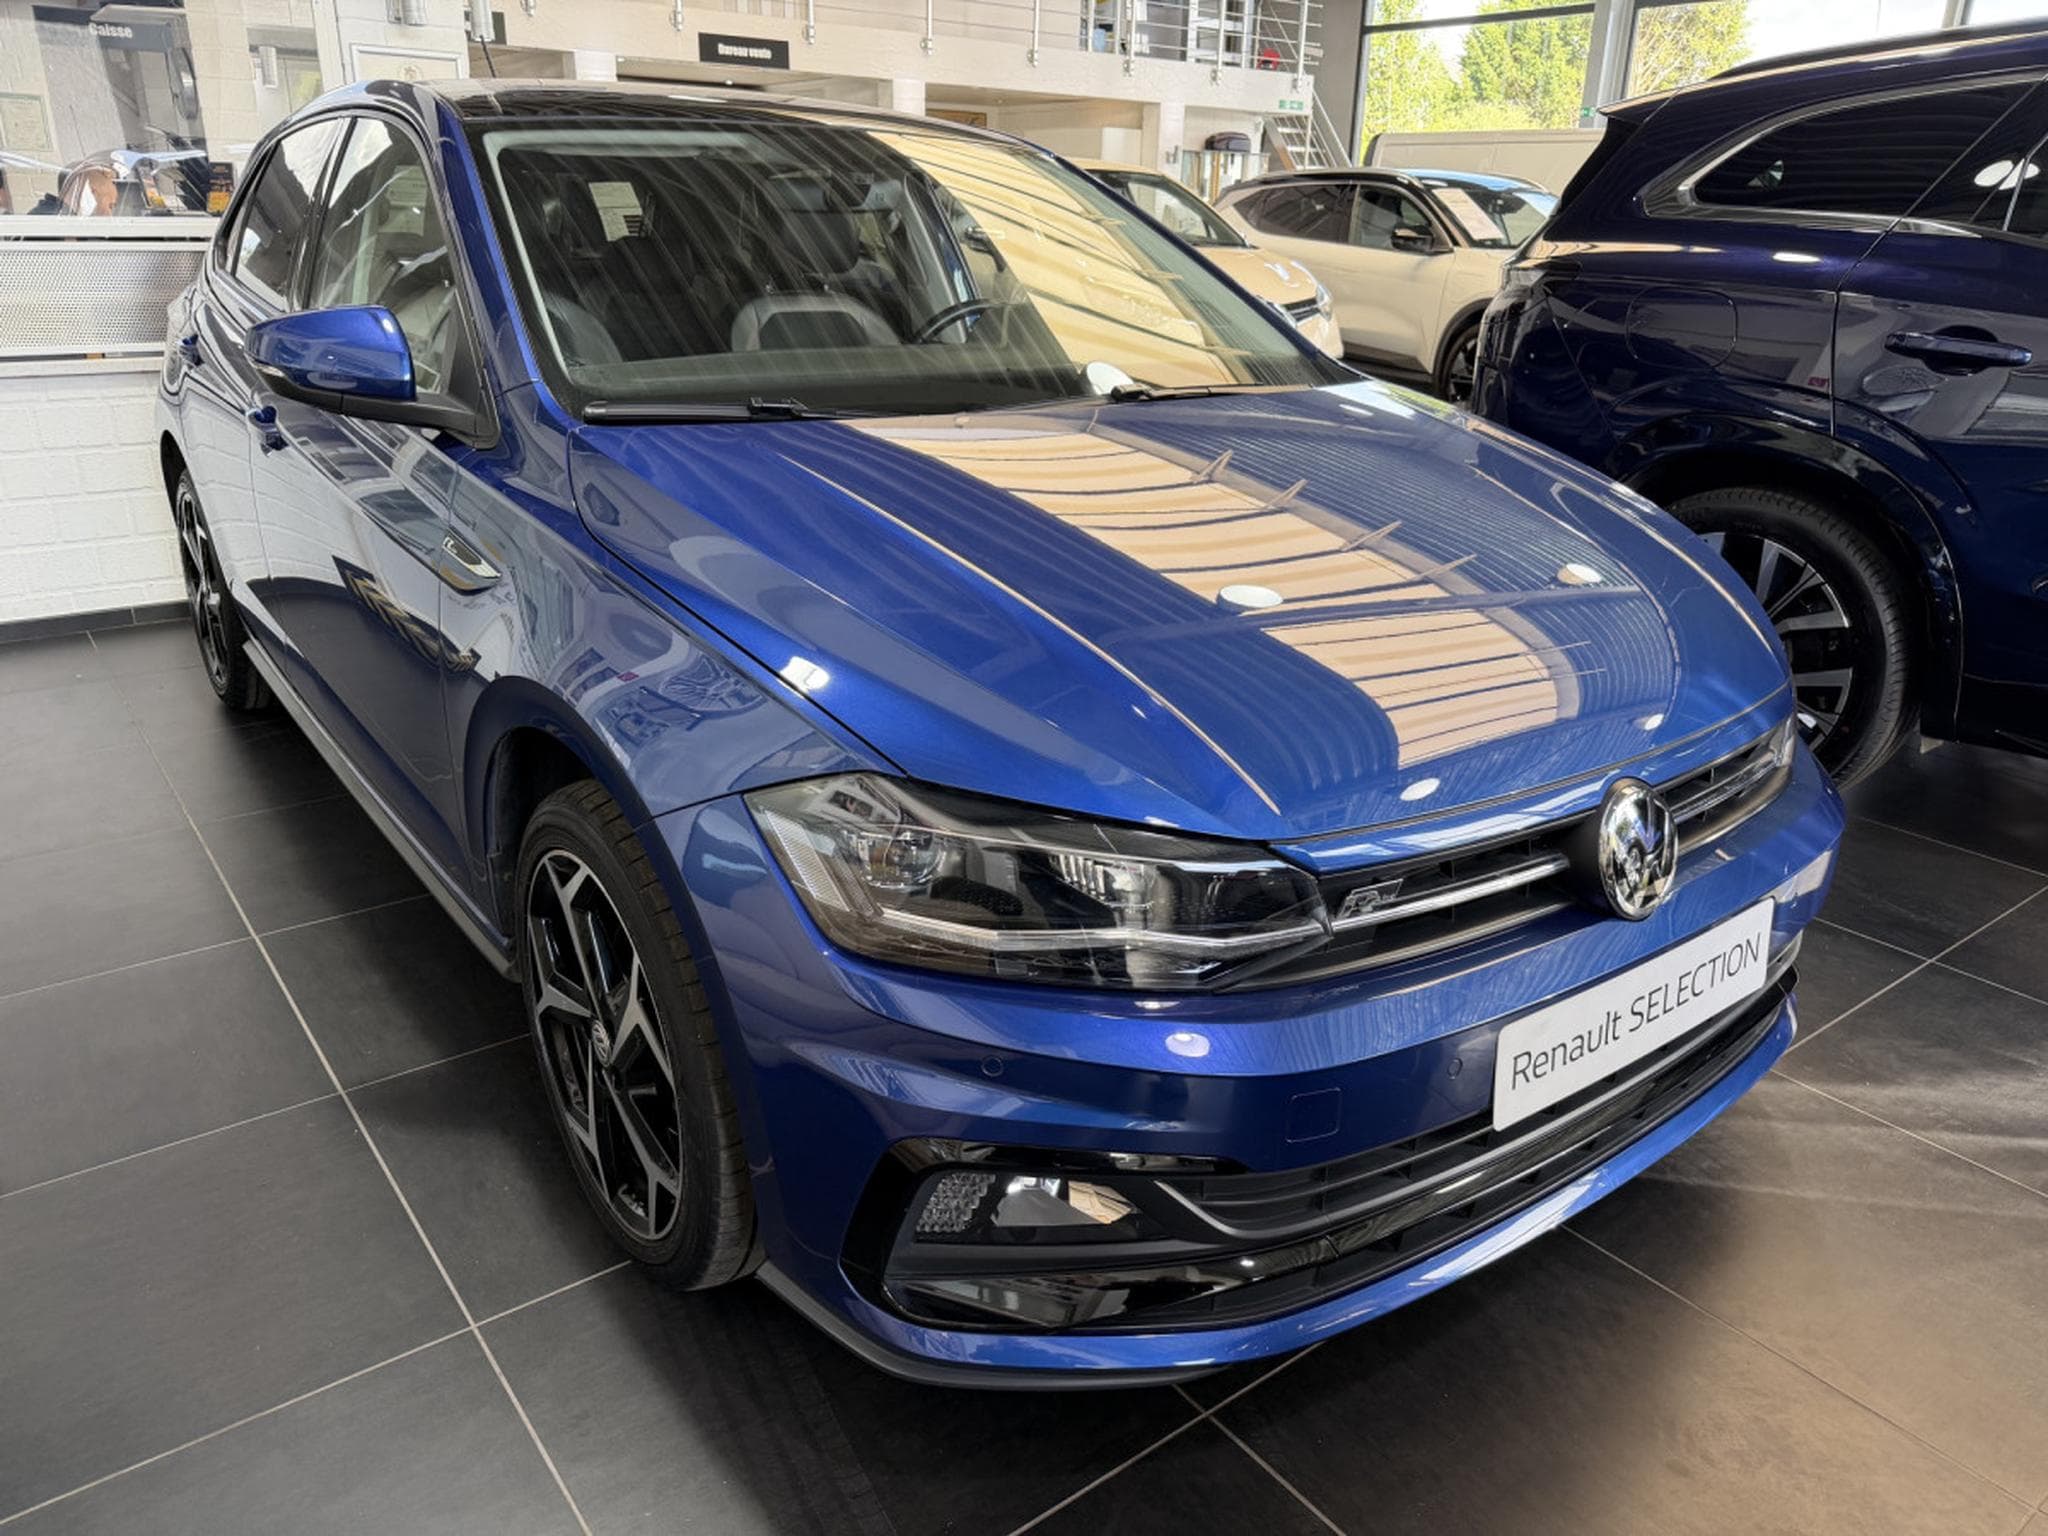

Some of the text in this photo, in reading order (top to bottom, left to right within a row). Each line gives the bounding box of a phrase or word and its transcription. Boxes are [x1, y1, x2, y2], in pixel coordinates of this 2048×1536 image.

[88, 22, 133, 39] Caisse
[1511, 931, 1762, 1091] Renault SELECTION
